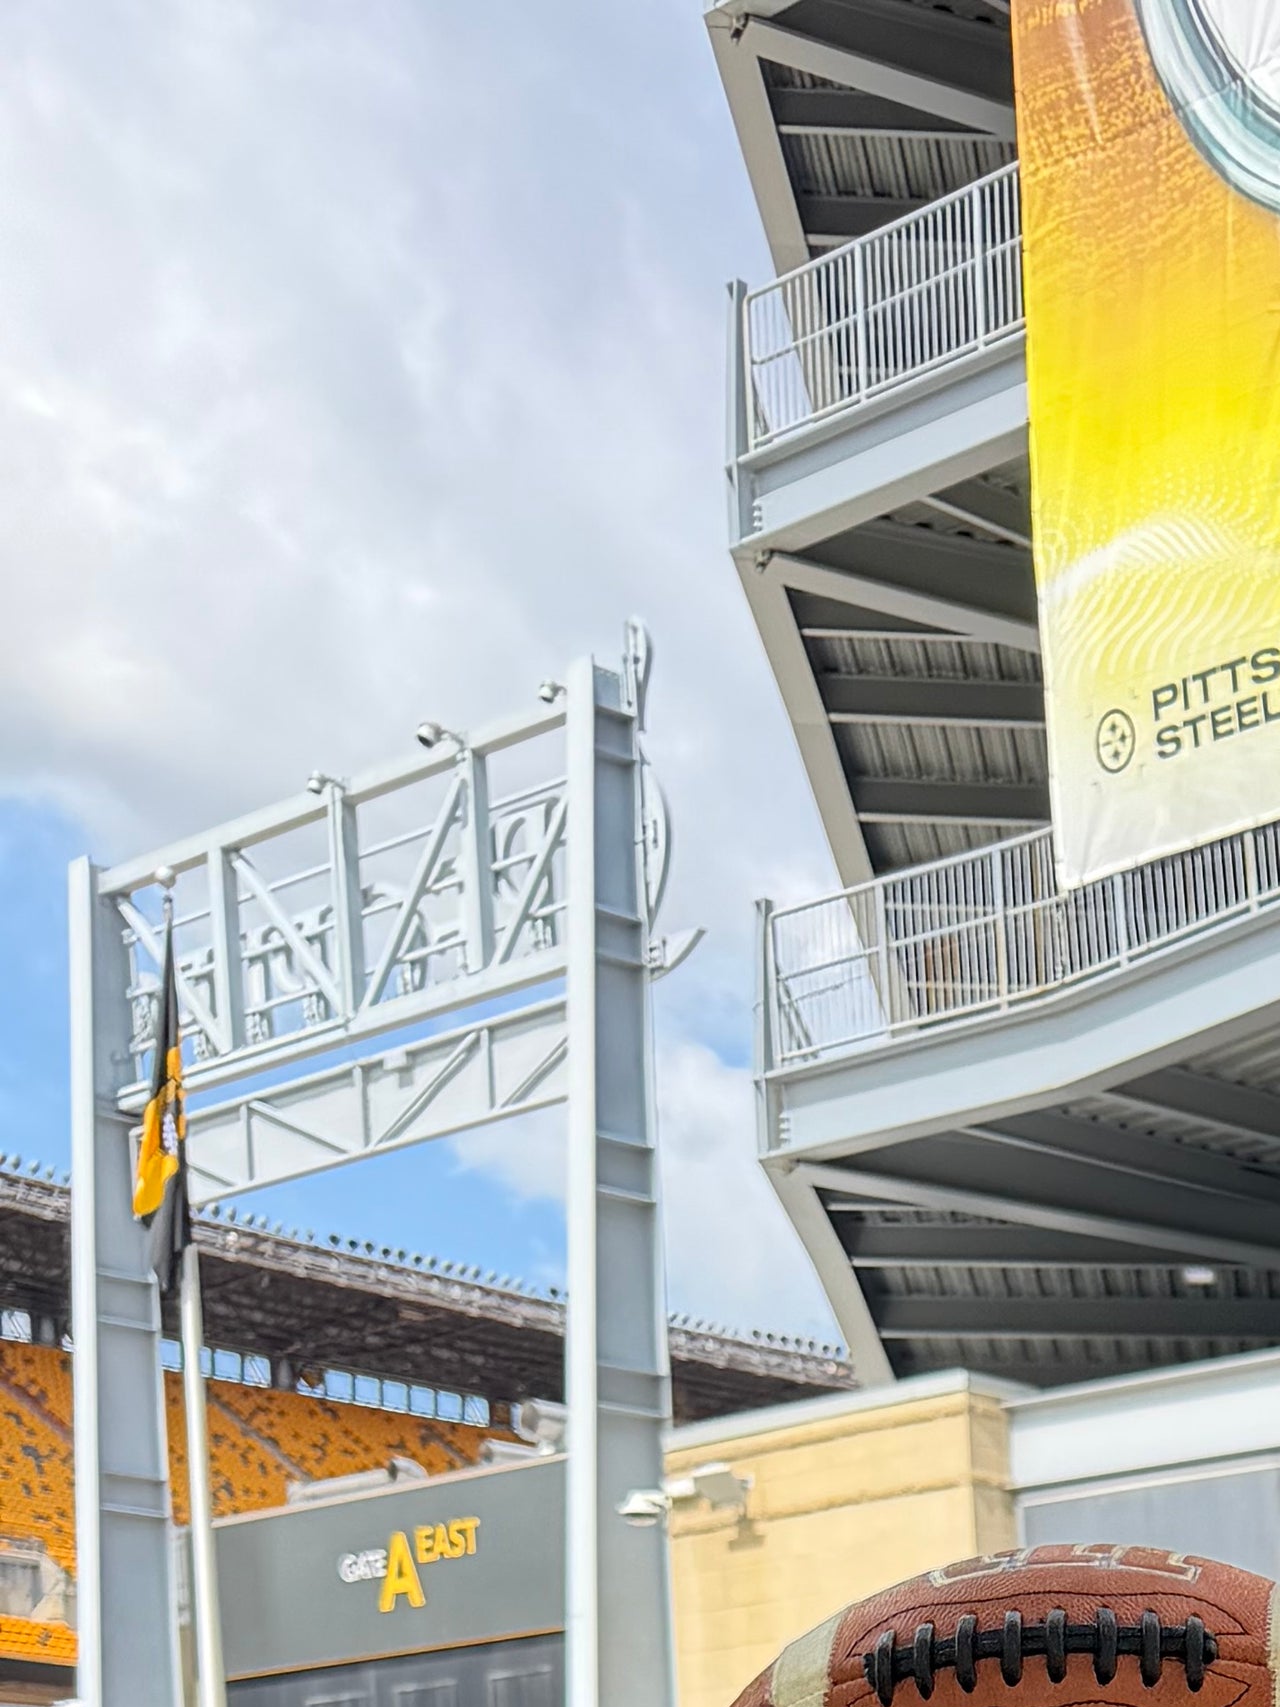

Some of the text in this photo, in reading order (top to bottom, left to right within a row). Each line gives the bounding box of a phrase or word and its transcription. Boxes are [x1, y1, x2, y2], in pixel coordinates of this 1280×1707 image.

[338, 1516, 481, 1613] GATE A EAST
